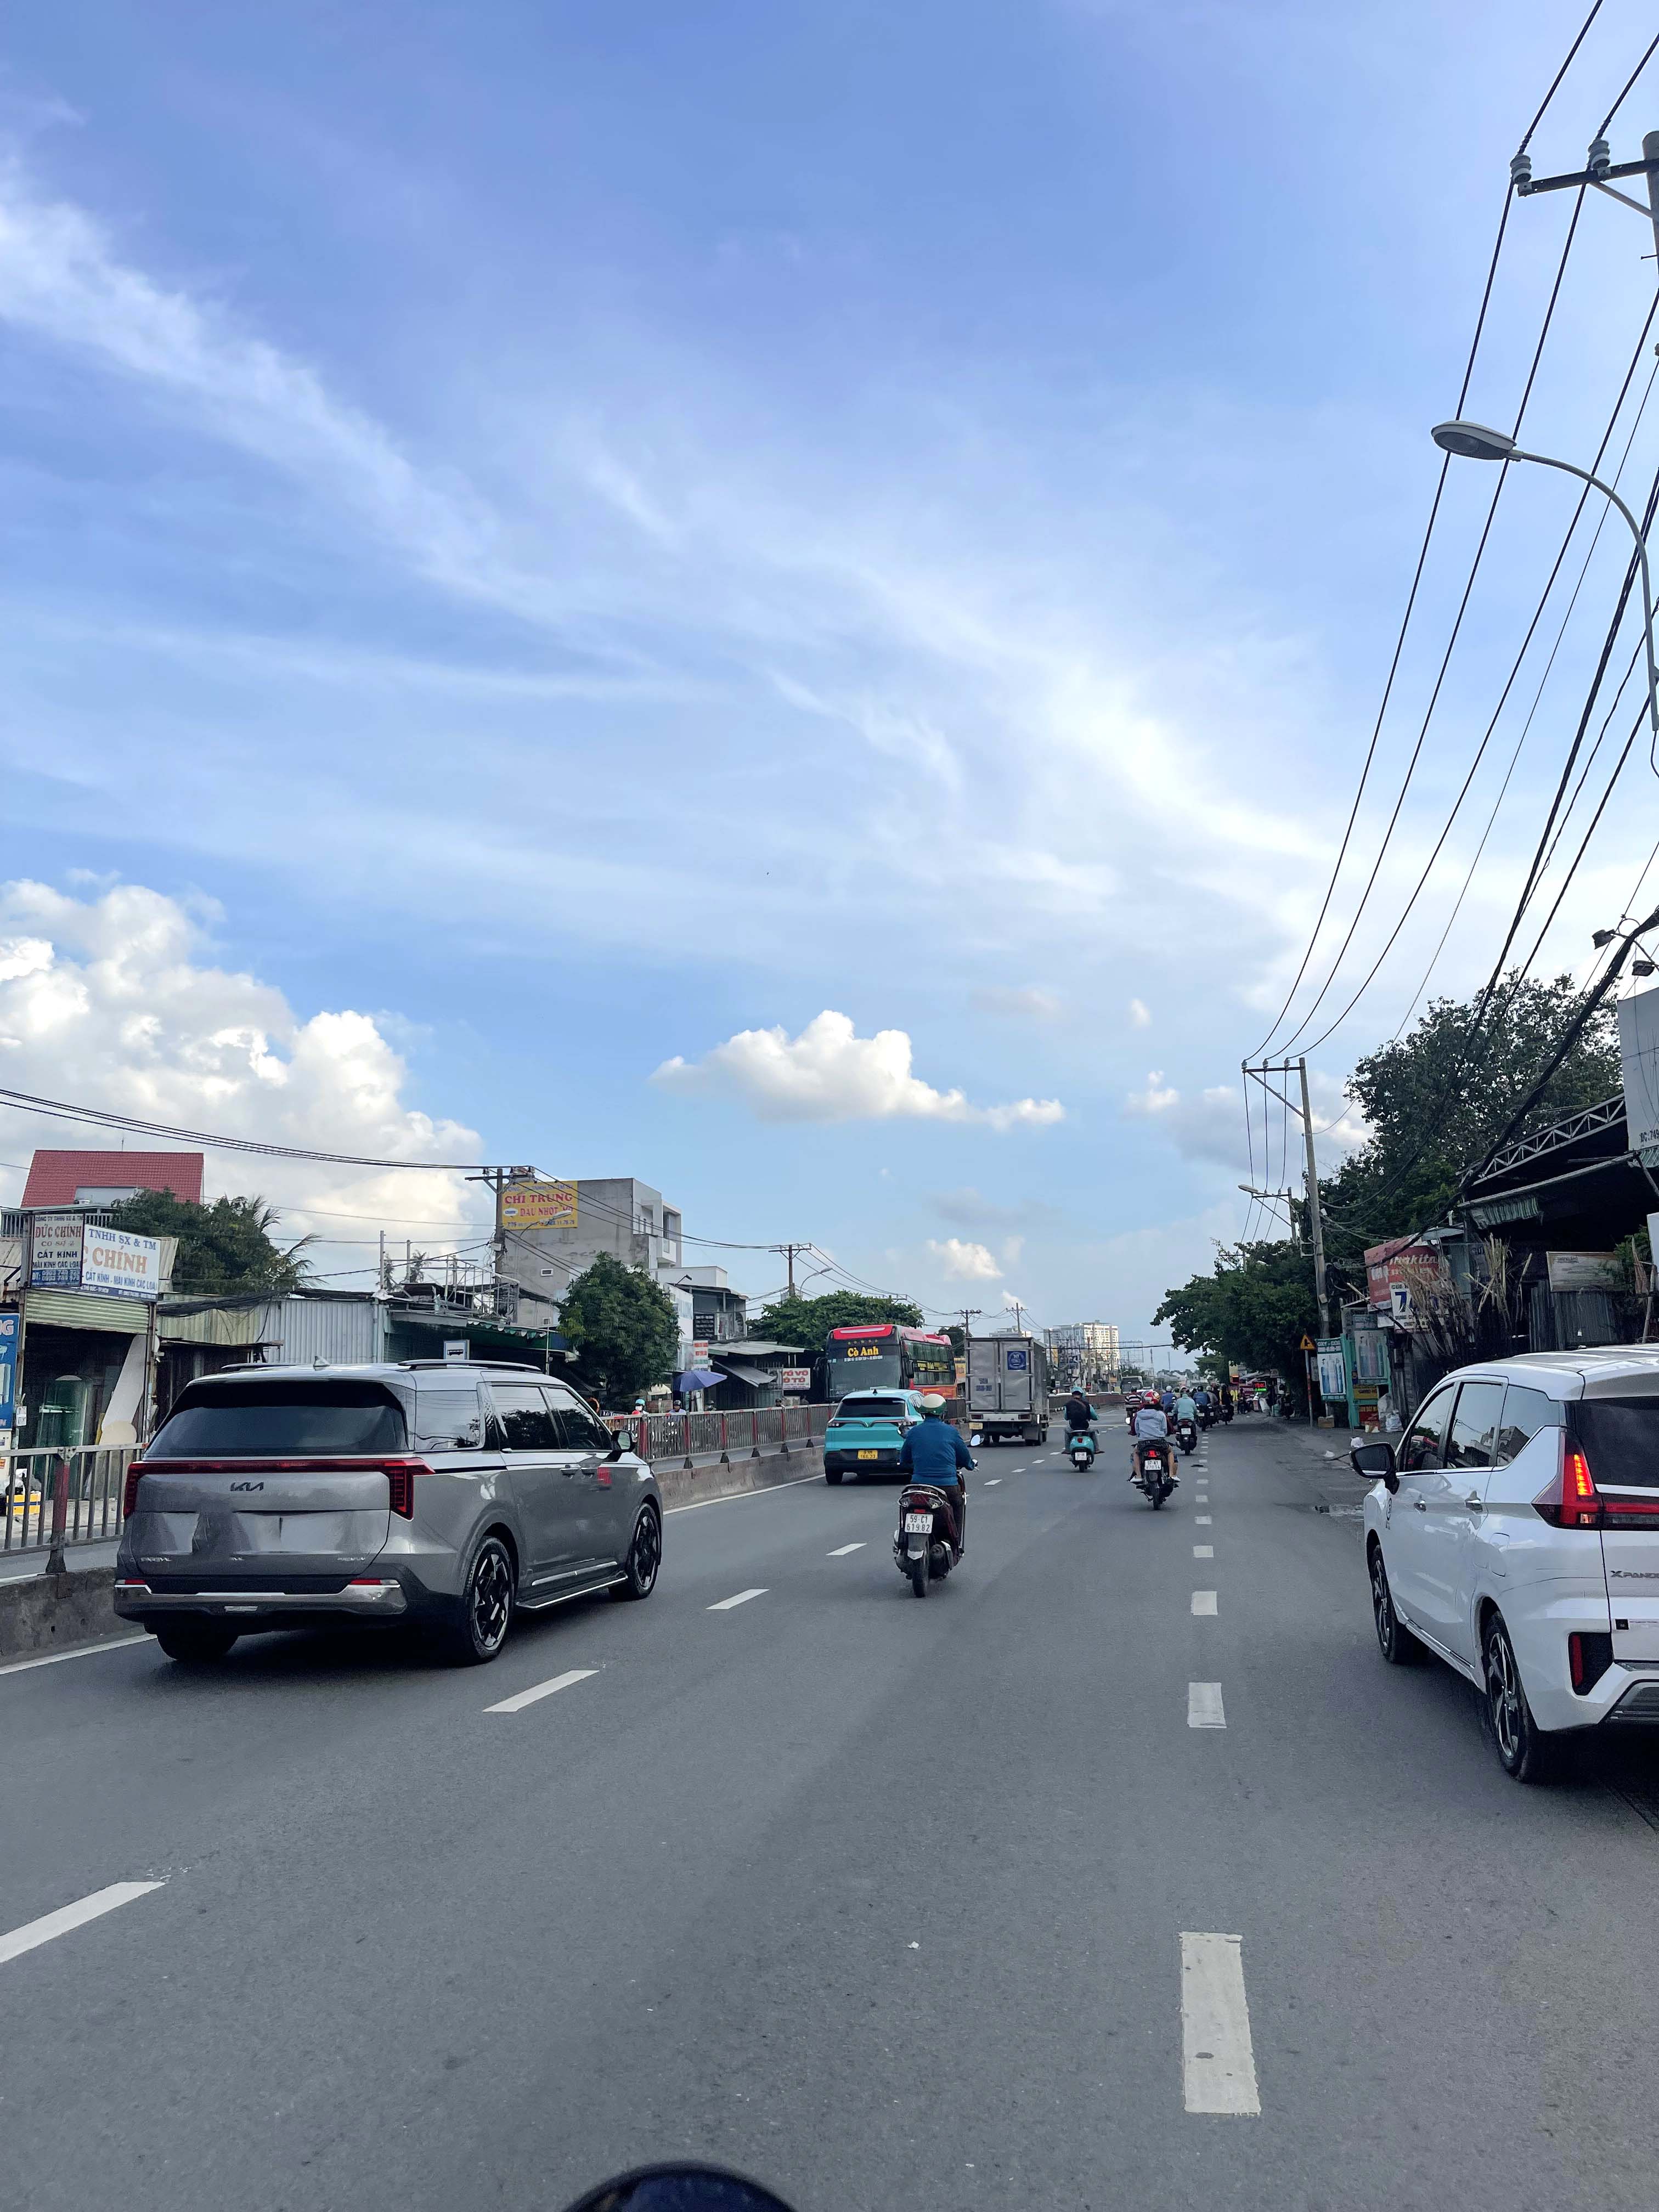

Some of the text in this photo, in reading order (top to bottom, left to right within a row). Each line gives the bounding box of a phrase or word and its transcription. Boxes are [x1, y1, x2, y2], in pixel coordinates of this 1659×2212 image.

[35, 1224, 82, 1238] ĐỨC CHÍNH
[88, 1229, 156, 1250] TNHH SX & TM
[92, 1245, 148, 1274] CHÍNH
[860, 1346, 879, 1356] Anh
[910, 1515, 928, 1523] 59-C1
